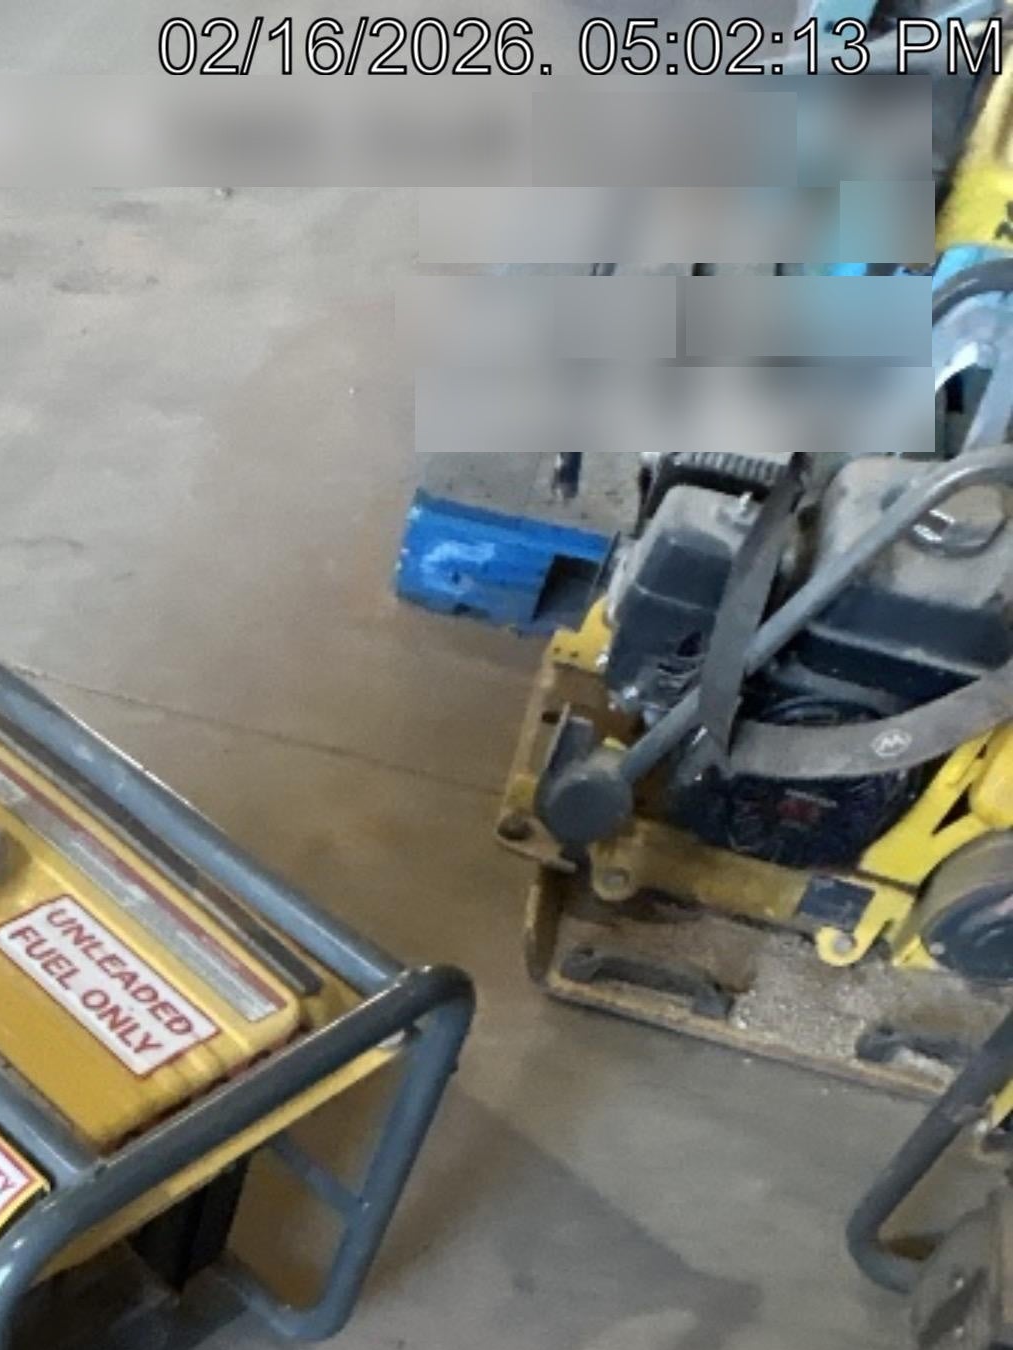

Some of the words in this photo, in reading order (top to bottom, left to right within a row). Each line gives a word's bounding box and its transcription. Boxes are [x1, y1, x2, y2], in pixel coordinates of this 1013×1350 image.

[8, 925, 80, 990] FUEL
[80, 989, 164, 1054] ONLY
[46, 908, 194, 1036] UNLEADED
